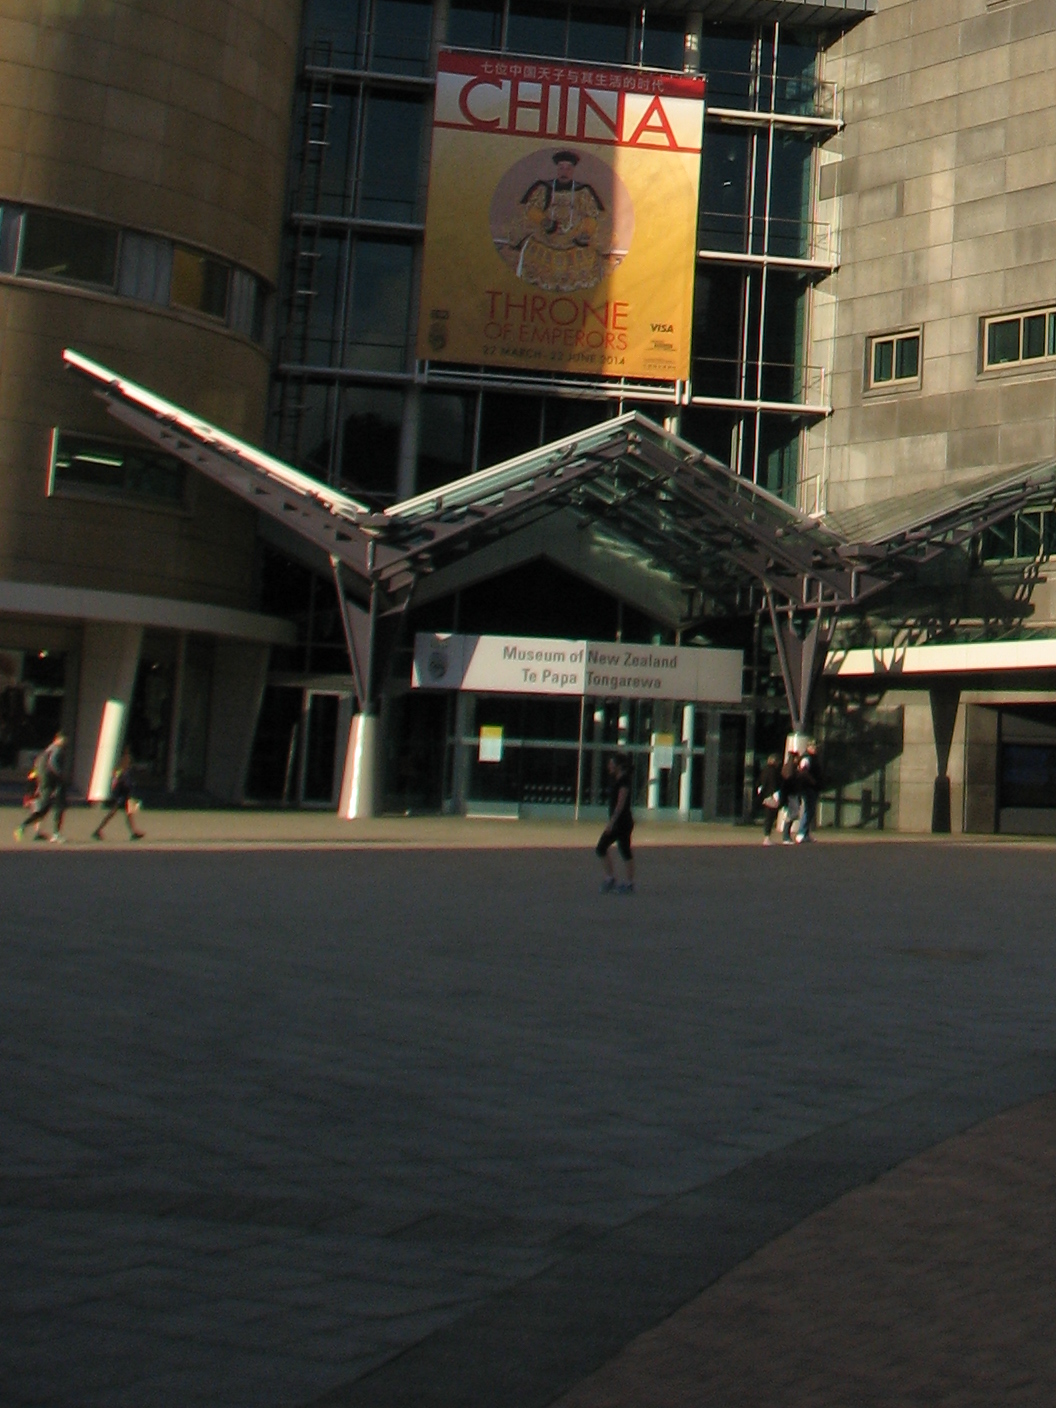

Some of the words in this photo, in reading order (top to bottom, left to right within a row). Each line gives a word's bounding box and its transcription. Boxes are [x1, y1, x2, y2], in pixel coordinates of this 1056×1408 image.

[480, 60, 666, 93] 七位中国天子与其生活的时代
[458, 75, 679, 149] CHINA
[484, 290, 630, 331] THRONE
[484, 321, 513, 340] OF
[519, 324, 628, 351] EMPERORS
[650, 323, 674, 333] VISA
[501, 346, 542, 360] MARCH
[568, 353, 597, 363] JUNE
[602, 355, 626, 366] 2014
[502, 645, 565, 663] Museum
[569, 649, 584, 664] of
[587, 650, 620, 666] New
[623, 652, 678, 669] Zealand
[521, 667, 537, 683] Te
[541, 669, 577, 688] Papa
[586, 670, 662, 690] Tongarewa
